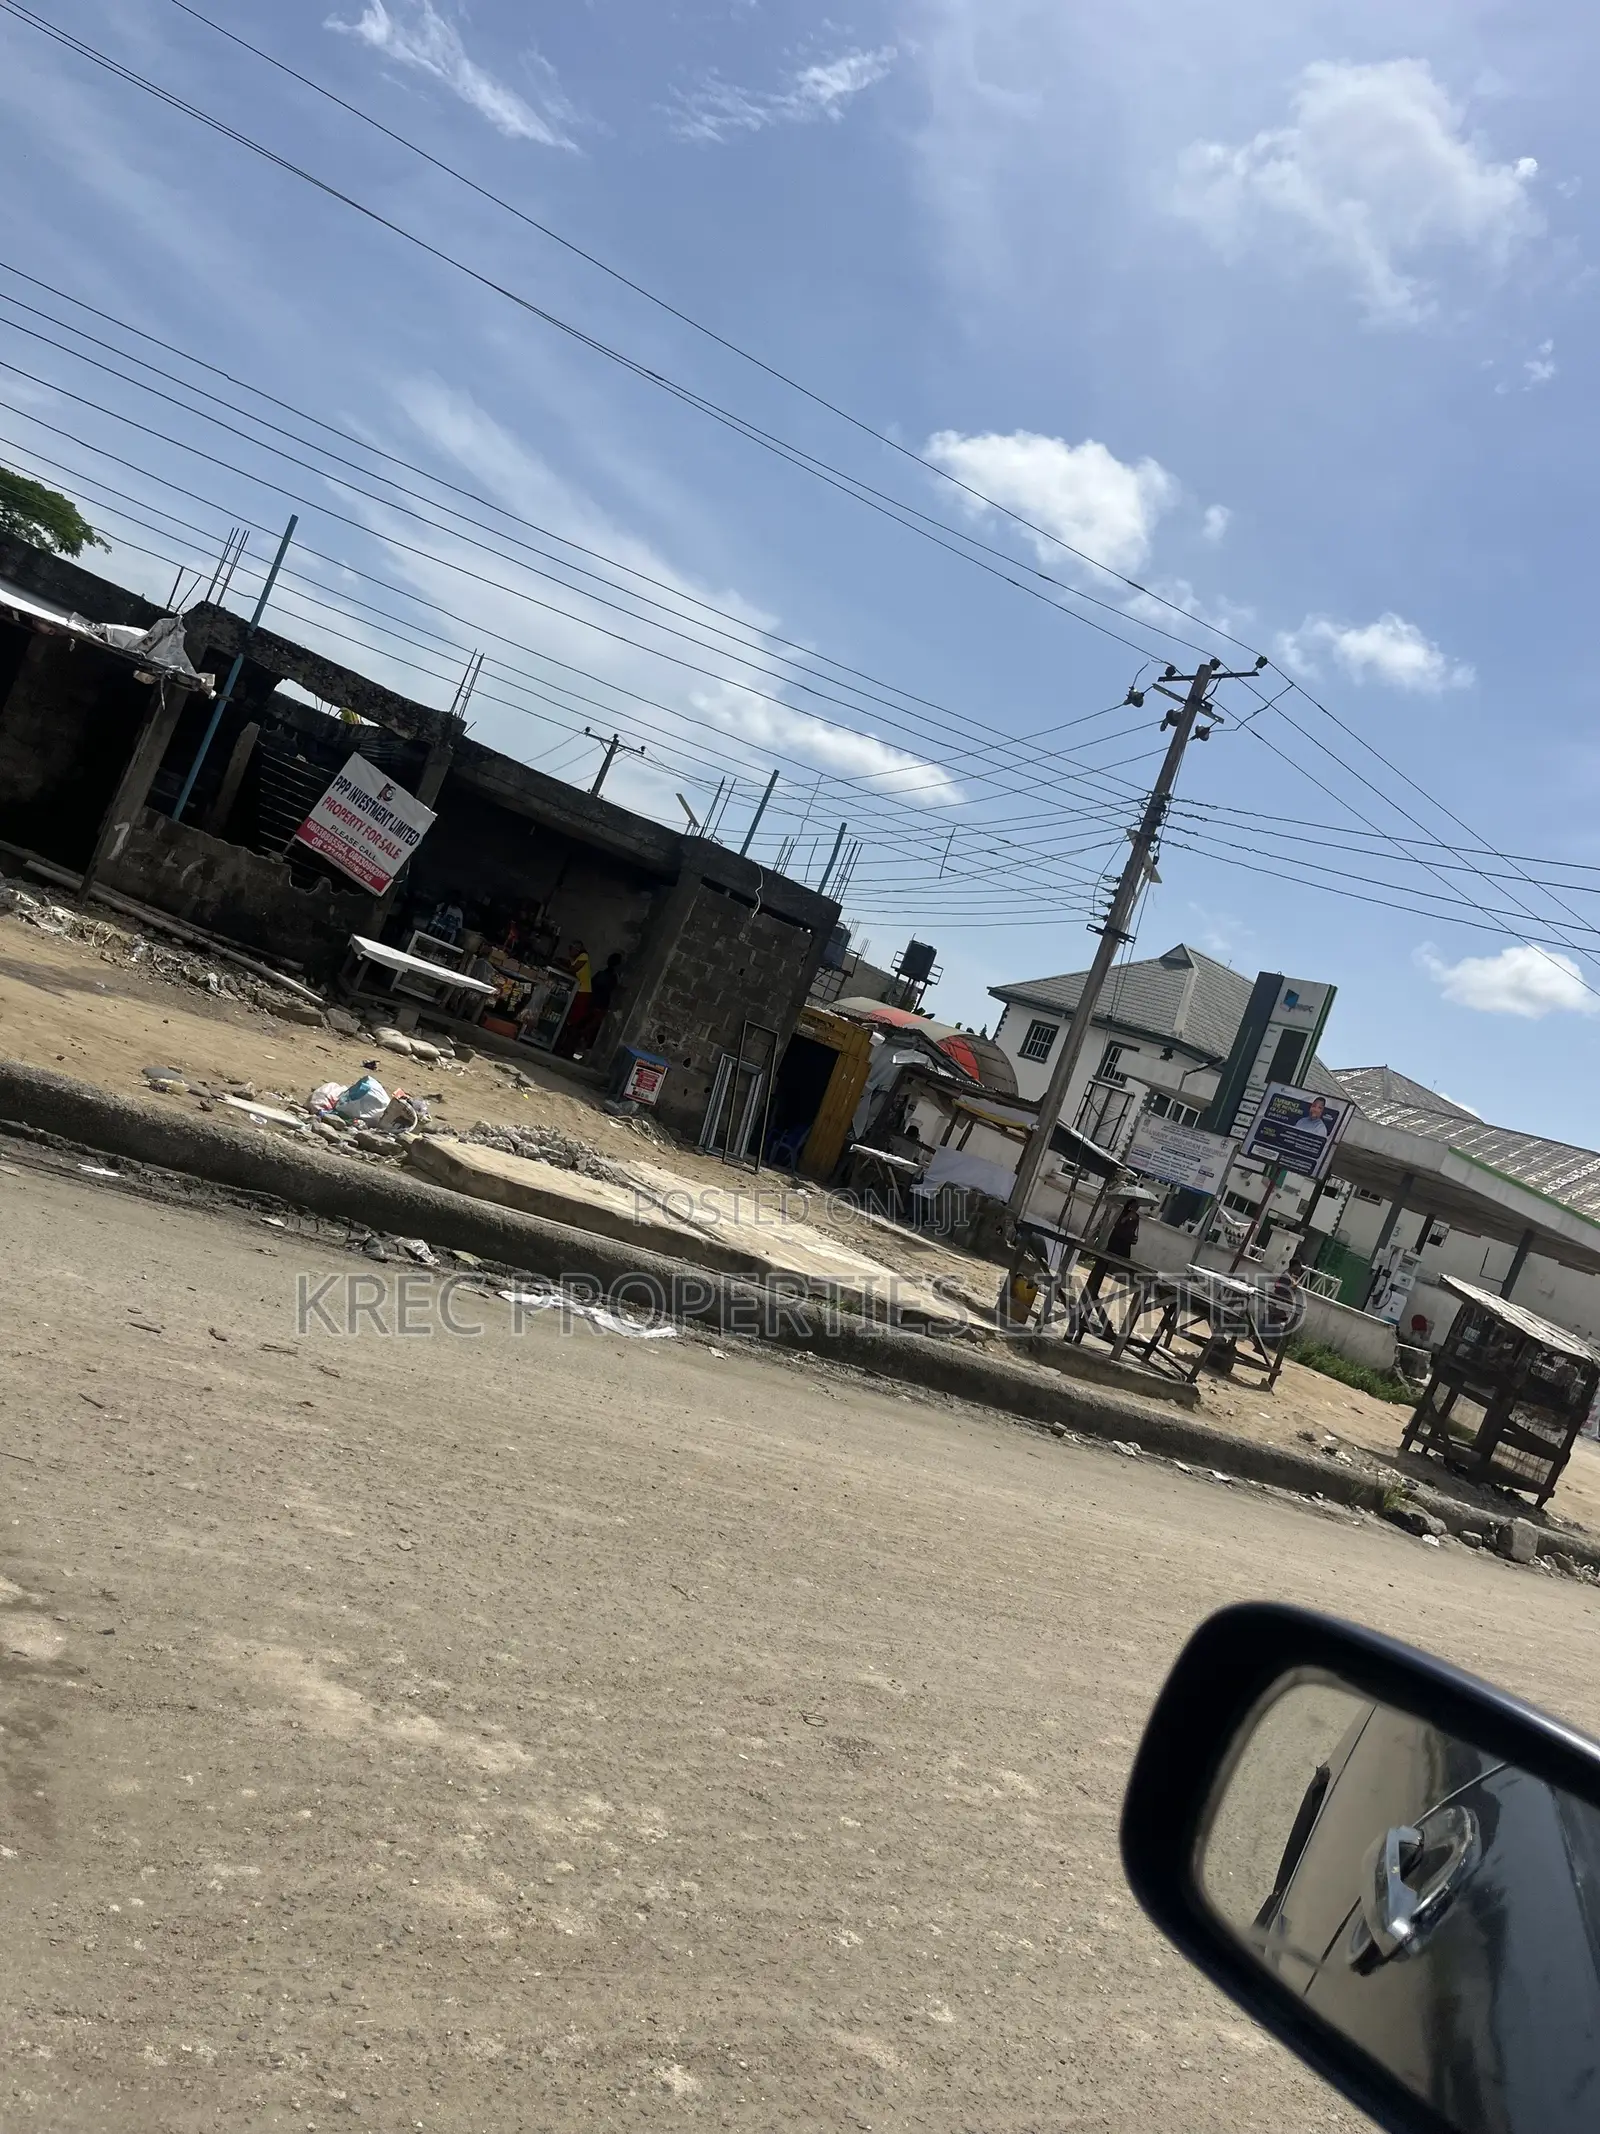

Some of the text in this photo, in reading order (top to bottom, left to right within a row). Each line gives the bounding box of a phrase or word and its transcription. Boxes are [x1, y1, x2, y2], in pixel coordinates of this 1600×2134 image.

[321, 796, 402, 860] PROPERTY FOR SALE
[332, 775, 421, 847] PPP INVESTMENT LIMITED
[311, 837, 324, 849] OR
[329, 824, 376, 861] PLEASE CALL
[1202, 1146, 1229, 1158] CHURCH
